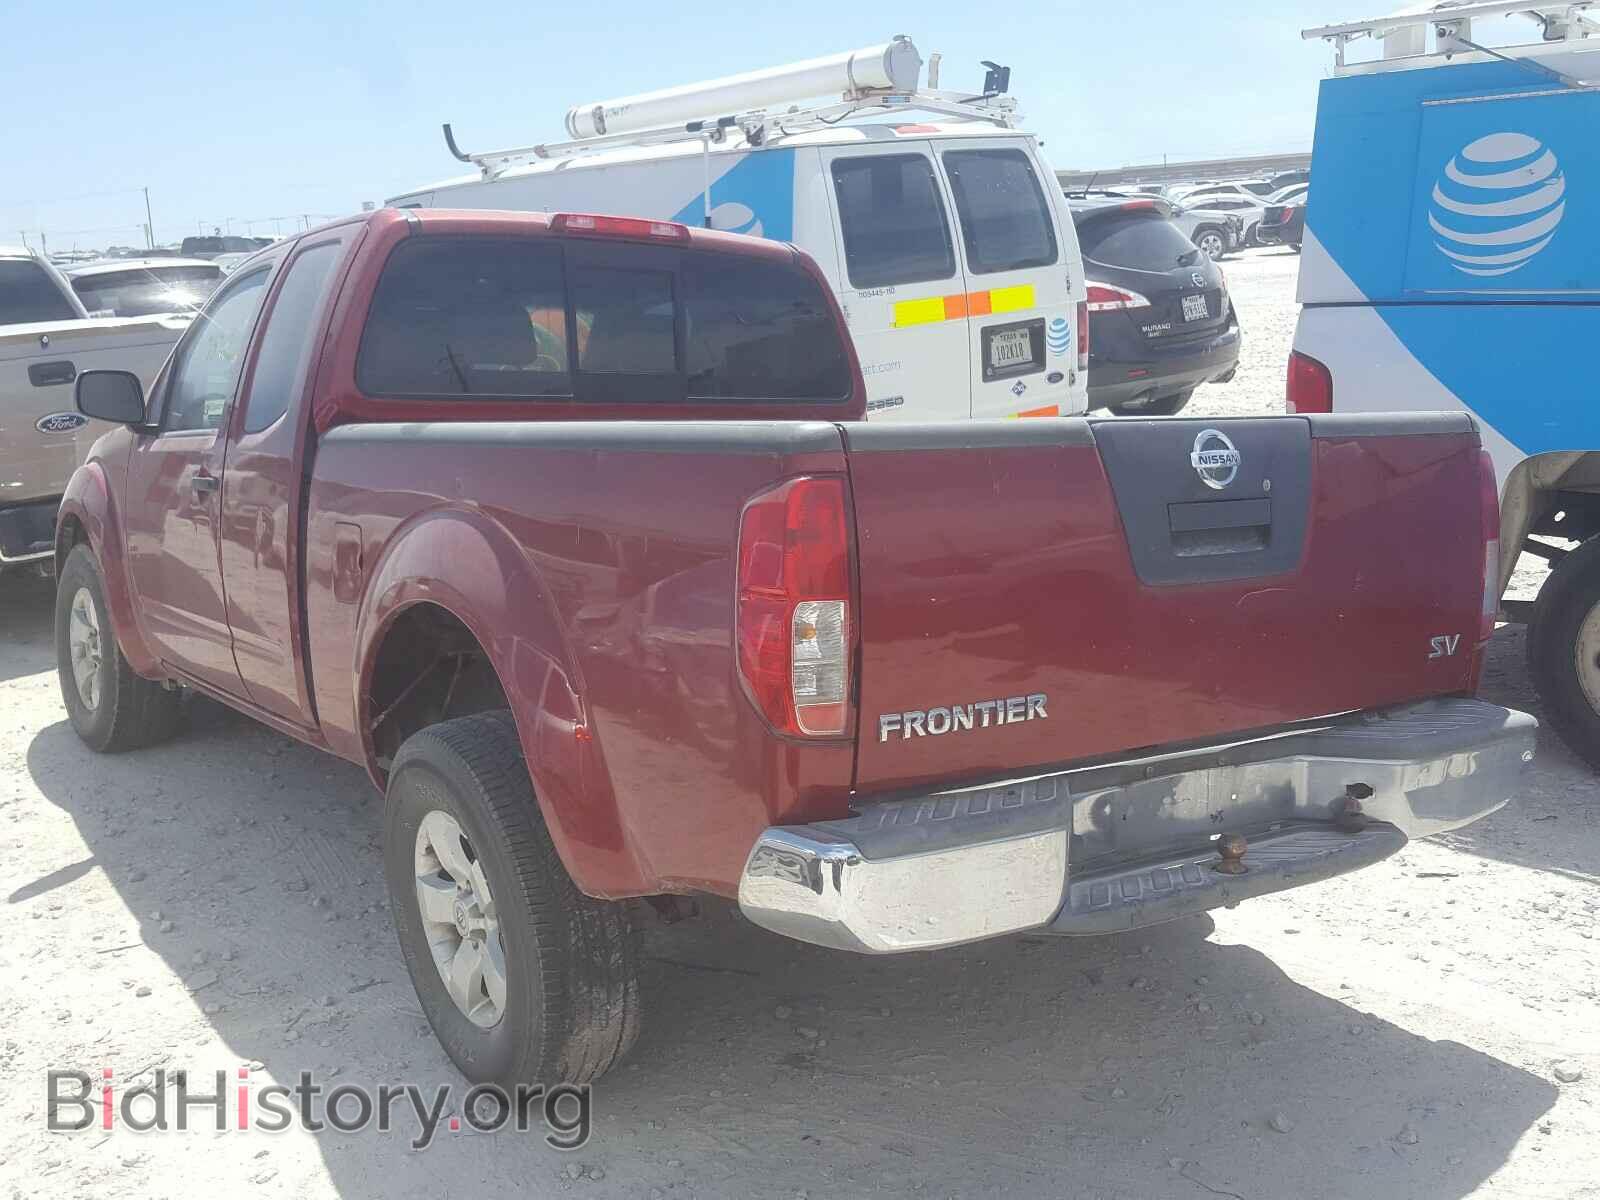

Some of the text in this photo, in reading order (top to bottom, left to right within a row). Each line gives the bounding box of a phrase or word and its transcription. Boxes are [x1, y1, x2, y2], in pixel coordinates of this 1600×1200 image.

[45, 414, 81, 431] Ford
[1198, 452, 1240, 466] NISSAN
[1428, 633, 1462, 659] SV
[878, 692, 1049, 743] FRONTIER
